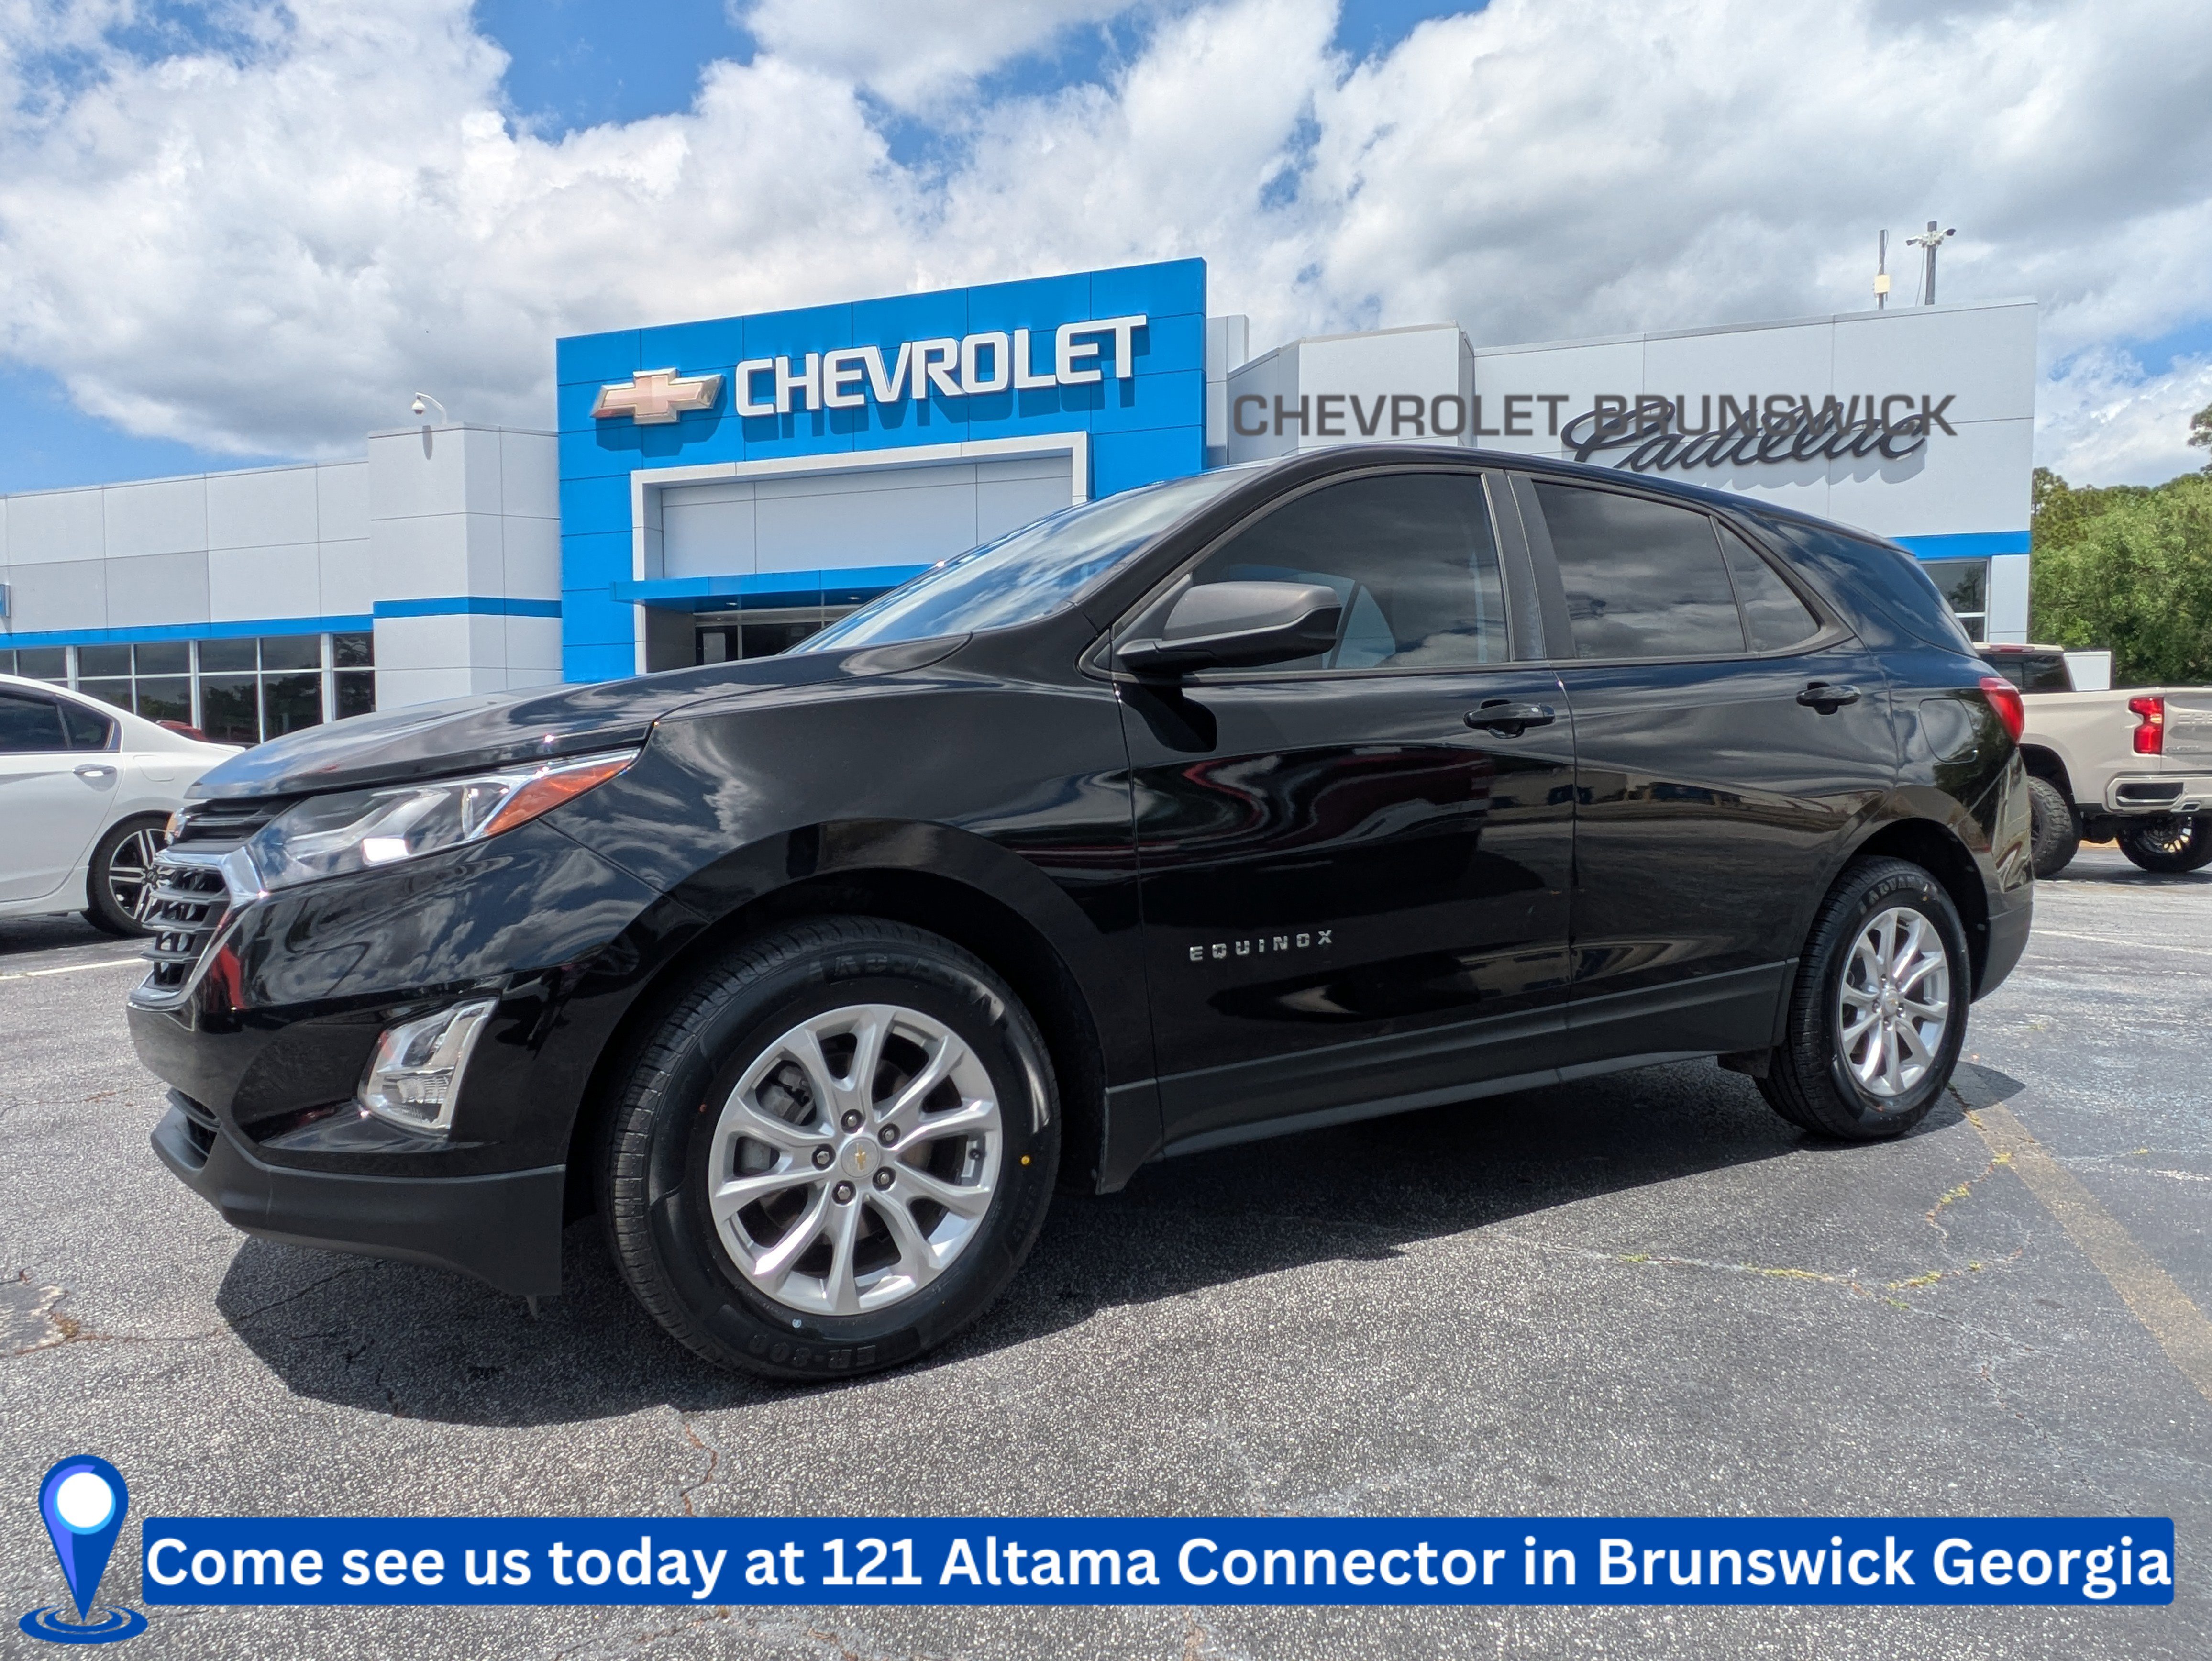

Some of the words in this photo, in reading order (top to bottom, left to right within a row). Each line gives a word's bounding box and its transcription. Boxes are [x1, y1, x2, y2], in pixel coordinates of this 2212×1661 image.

[735, 314, 1148, 416] CHEVROLET
[1560, 400, 1926, 473] Cadillac
[1189, 930, 1333, 961] EQUINOX
